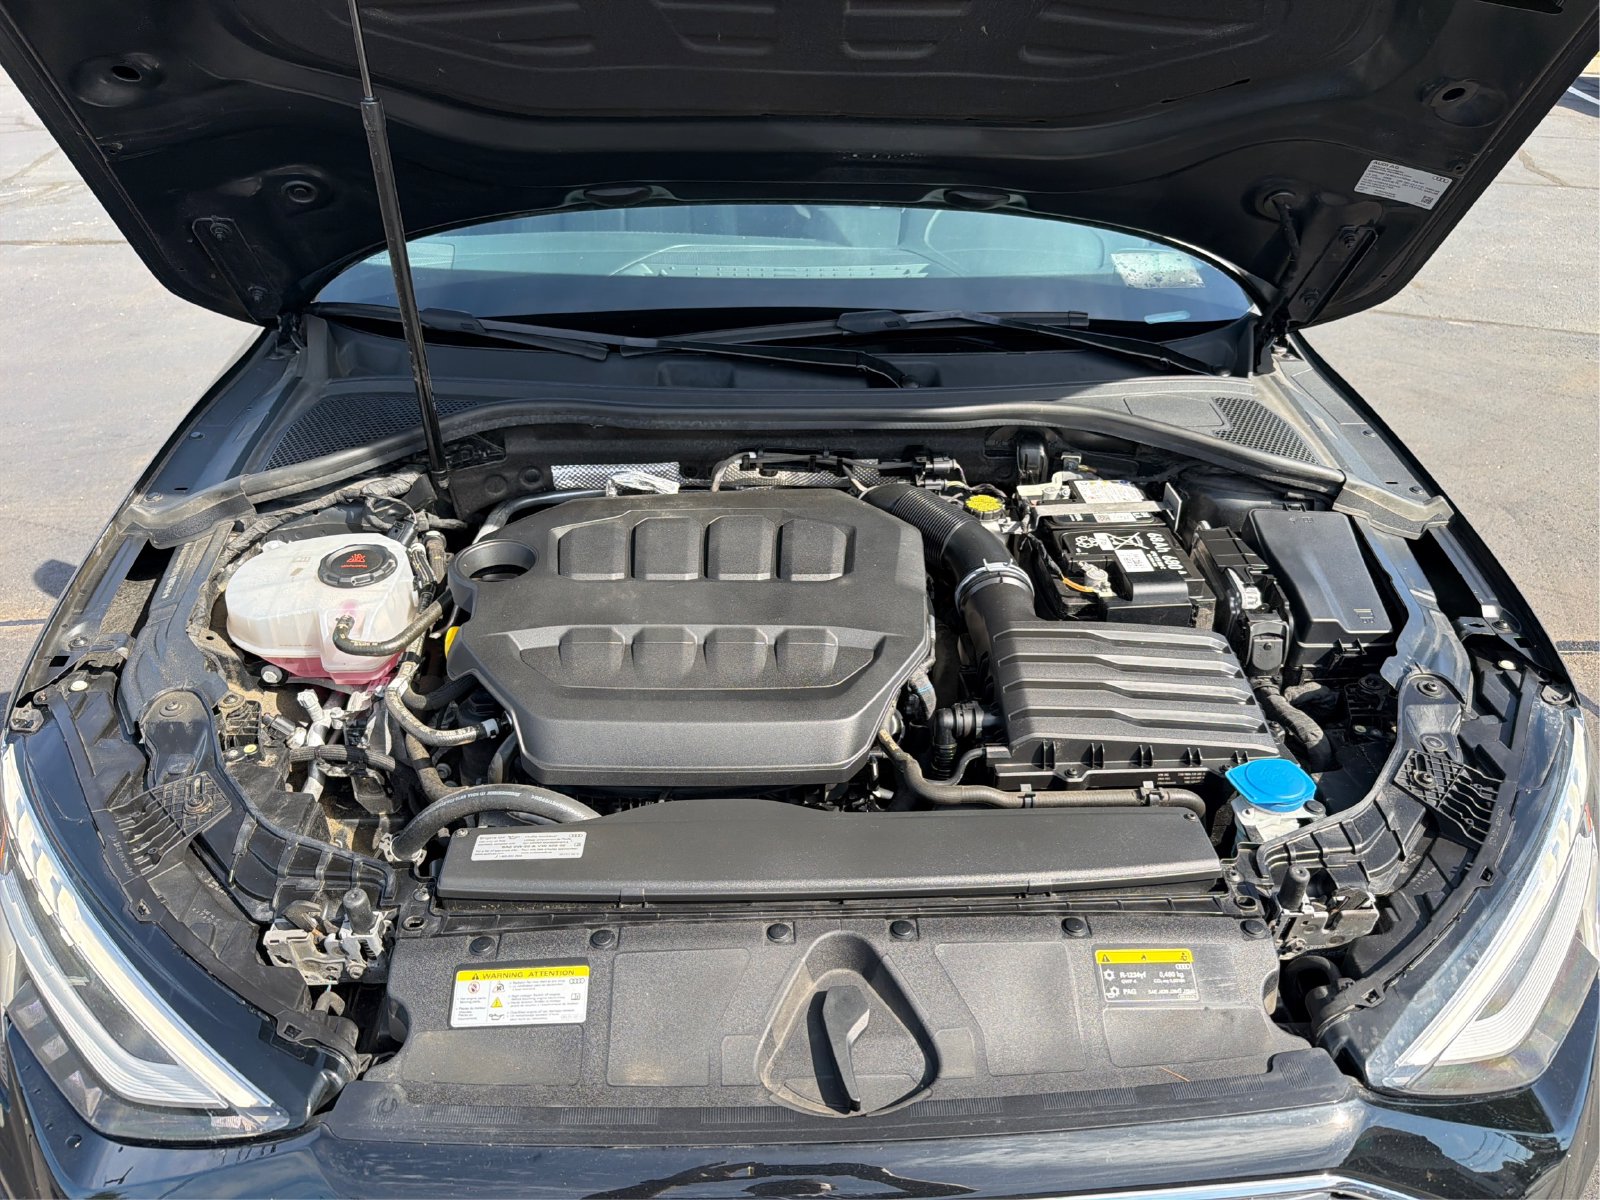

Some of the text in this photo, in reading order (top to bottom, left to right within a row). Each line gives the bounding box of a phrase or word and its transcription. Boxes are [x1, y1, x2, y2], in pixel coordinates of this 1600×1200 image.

[1146, 532, 1172, 553] 68Ah
[482, 969, 575, 979] WARNING ATTENTION
